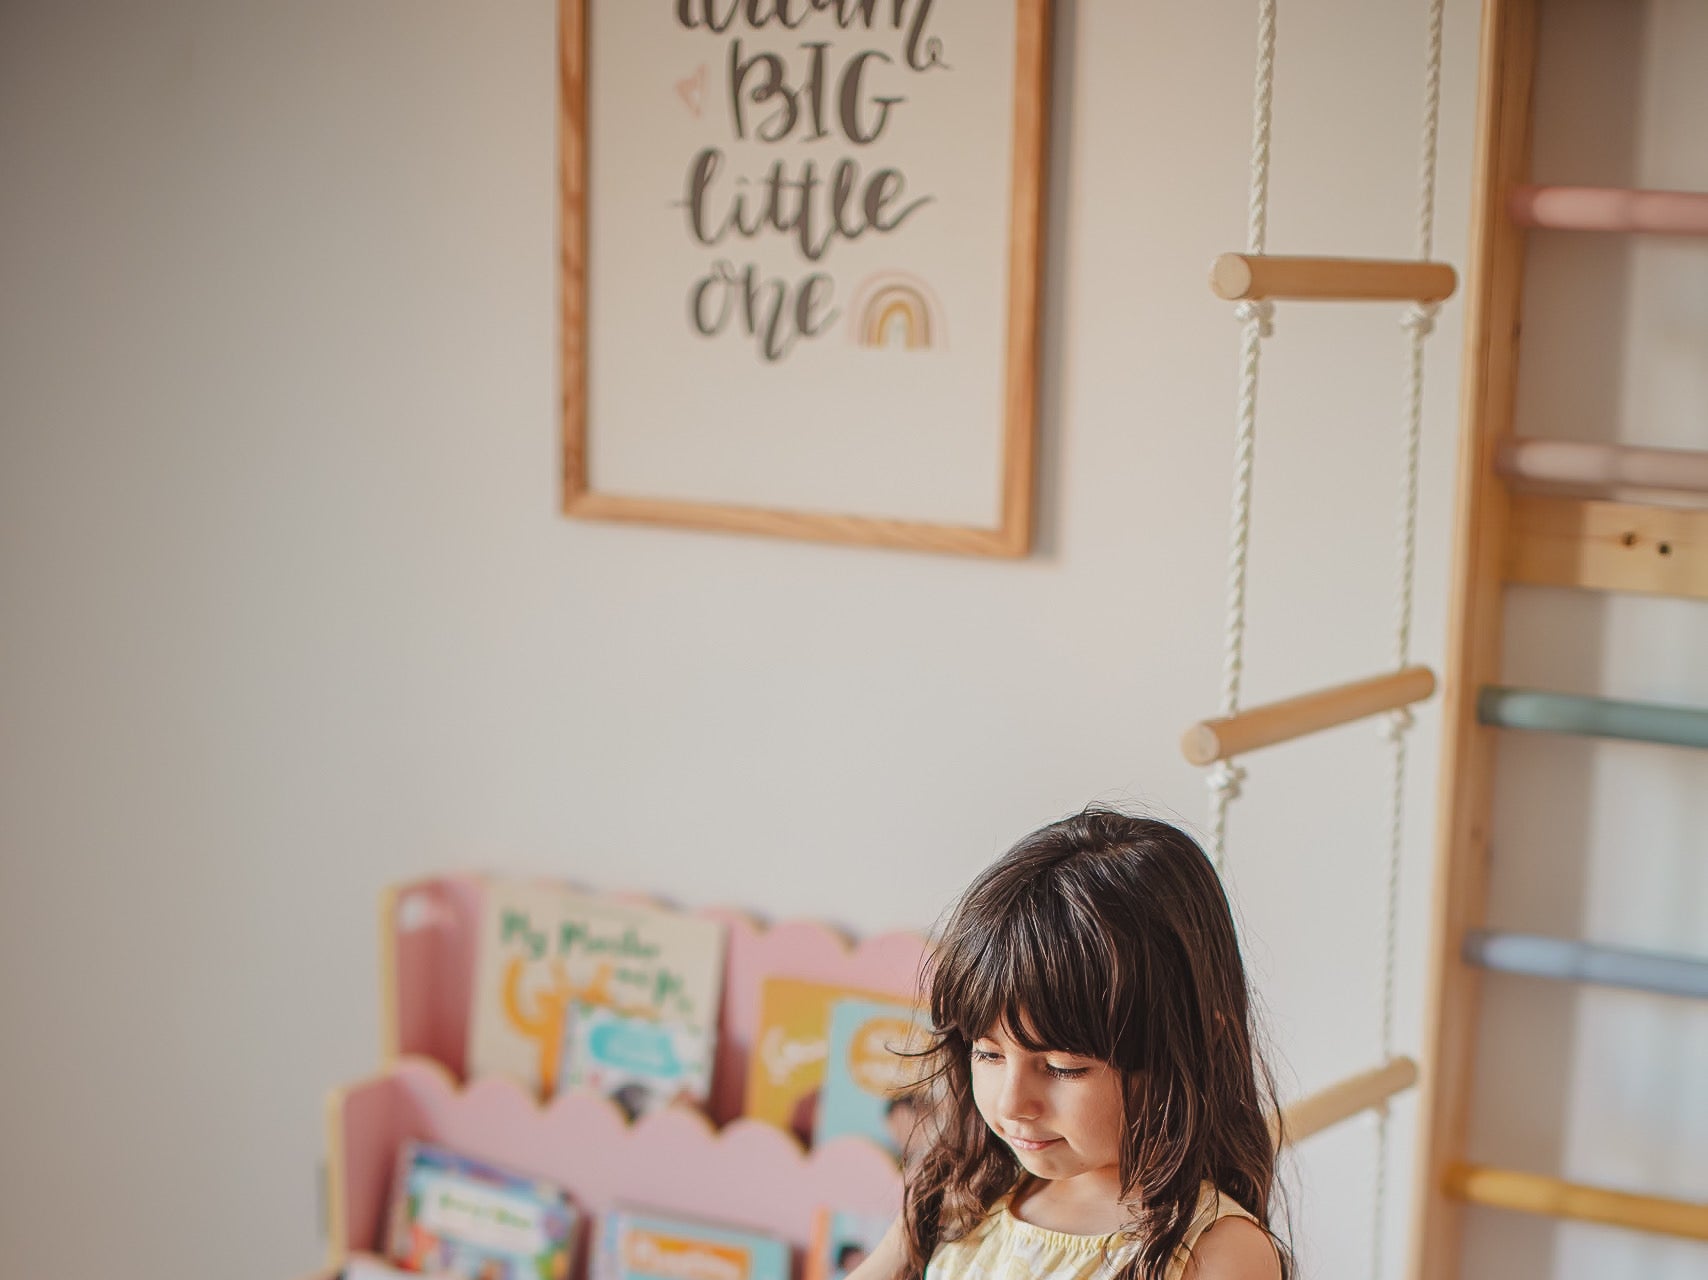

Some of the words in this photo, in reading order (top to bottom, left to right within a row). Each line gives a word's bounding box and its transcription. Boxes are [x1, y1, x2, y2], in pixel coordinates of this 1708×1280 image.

[728, 38, 906, 144] BIG
[670, 146, 936, 262] little
[692, 259, 839, 362] one
